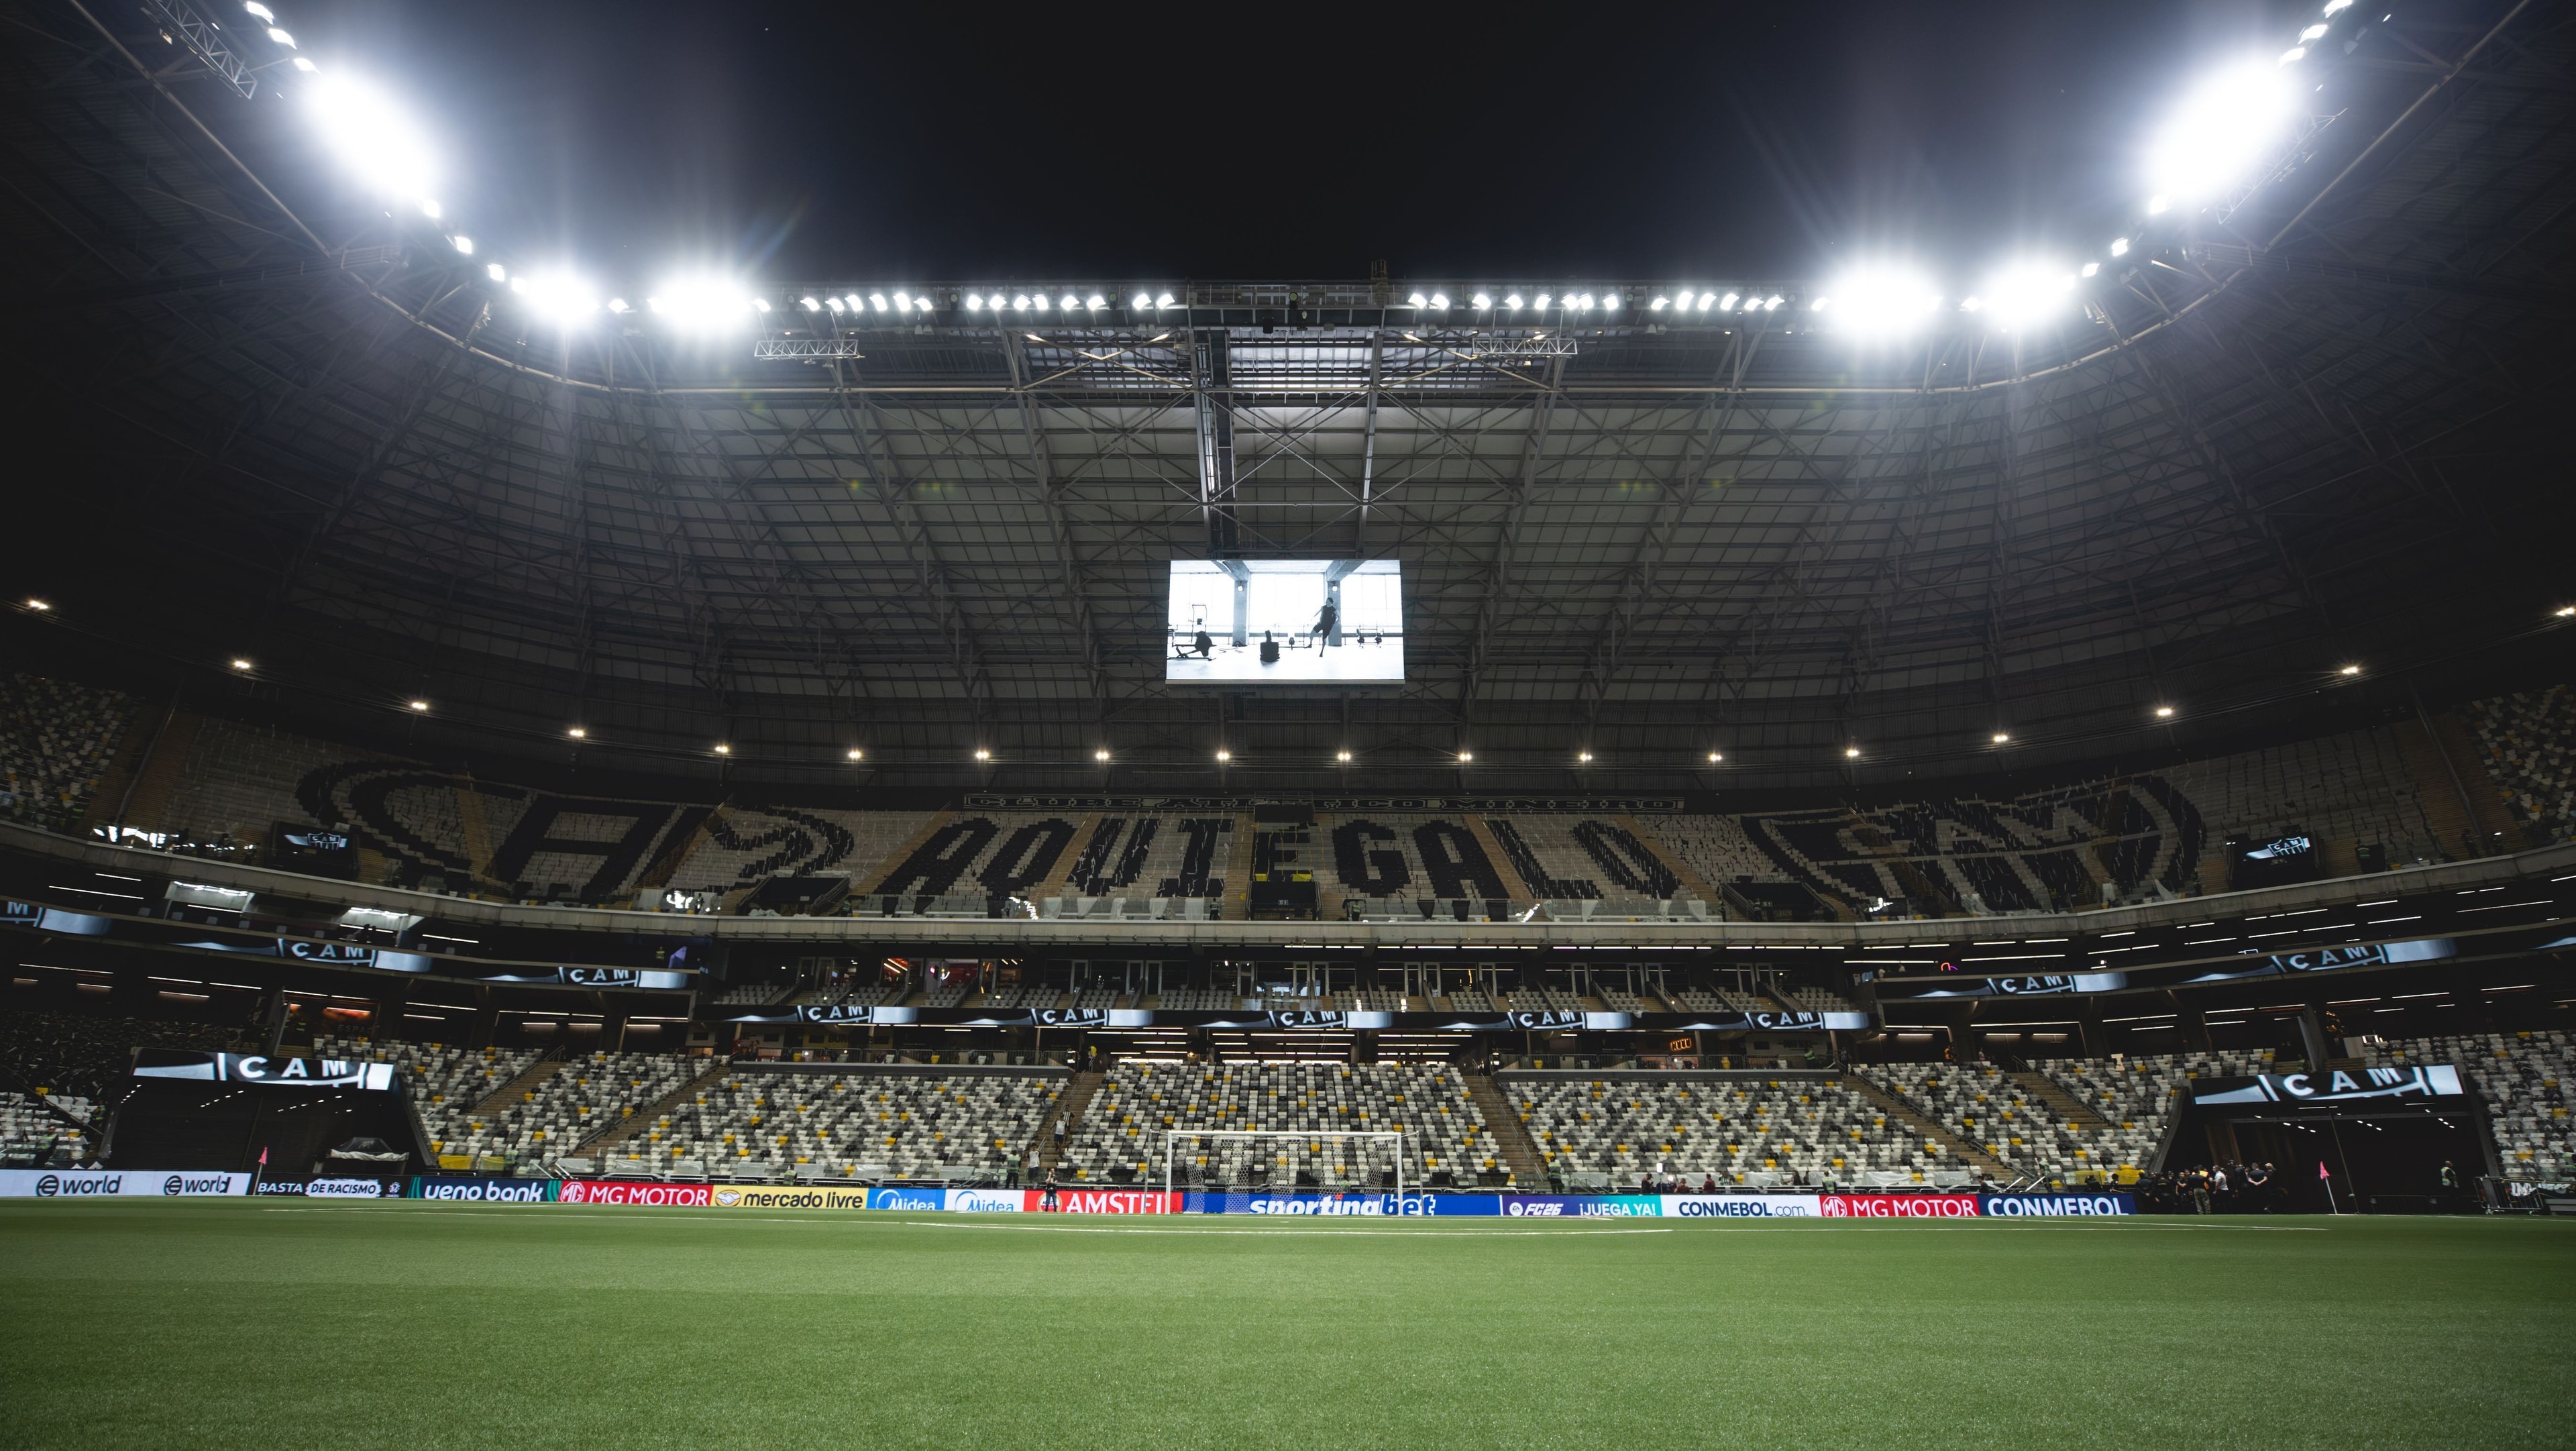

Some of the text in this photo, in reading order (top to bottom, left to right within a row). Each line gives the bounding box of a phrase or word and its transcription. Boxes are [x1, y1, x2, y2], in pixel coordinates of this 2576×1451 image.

[968, 796, 1676, 810] CLUBE ATLTICO MINEIRO
[2273, 840, 2299, 850] CAM
[1331, 819, 1682, 899] GALO
[291, 943, 364, 958] CAM
[2290, 947, 2369, 969] CAM
[570, 969, 629, 982] CAM
[2001, 975, 2063, 992] CAM
[808, 1006, 863, 1020] CAM
[1042, 1008, 1098, 1024] CAM
[1280, 1011, 1336, 1026] CAM
[1519, 1012, 1576, 1027] CAM
[1758, 1012, 1813, 1028] CAM
[239, 1057, 347, 1079] CAM
[2284, 1068, 2402, 1096] CAM
[62, 1175, 122, 1194] world
[185, 1175, 231, 1194] world
[258, 1183, 376, 1194] BASTA DE RACISMO
[425, 1181, 543, 1202] ueno bank
[590, 1186, 708, 1205] MG MOTOR
[743, 1191, 863, 1209] mercado livre
[889, 1198, 936, 1210] Midea
[967, 1199, 1014, 1212] Midea
[1579, 1203, 1656, 1216] ¡JUEGA YA!
[1853, 1199, 1976, 1217] MG MOTOR
[1988, 1197, 2129, 1216] CONMEBOL
